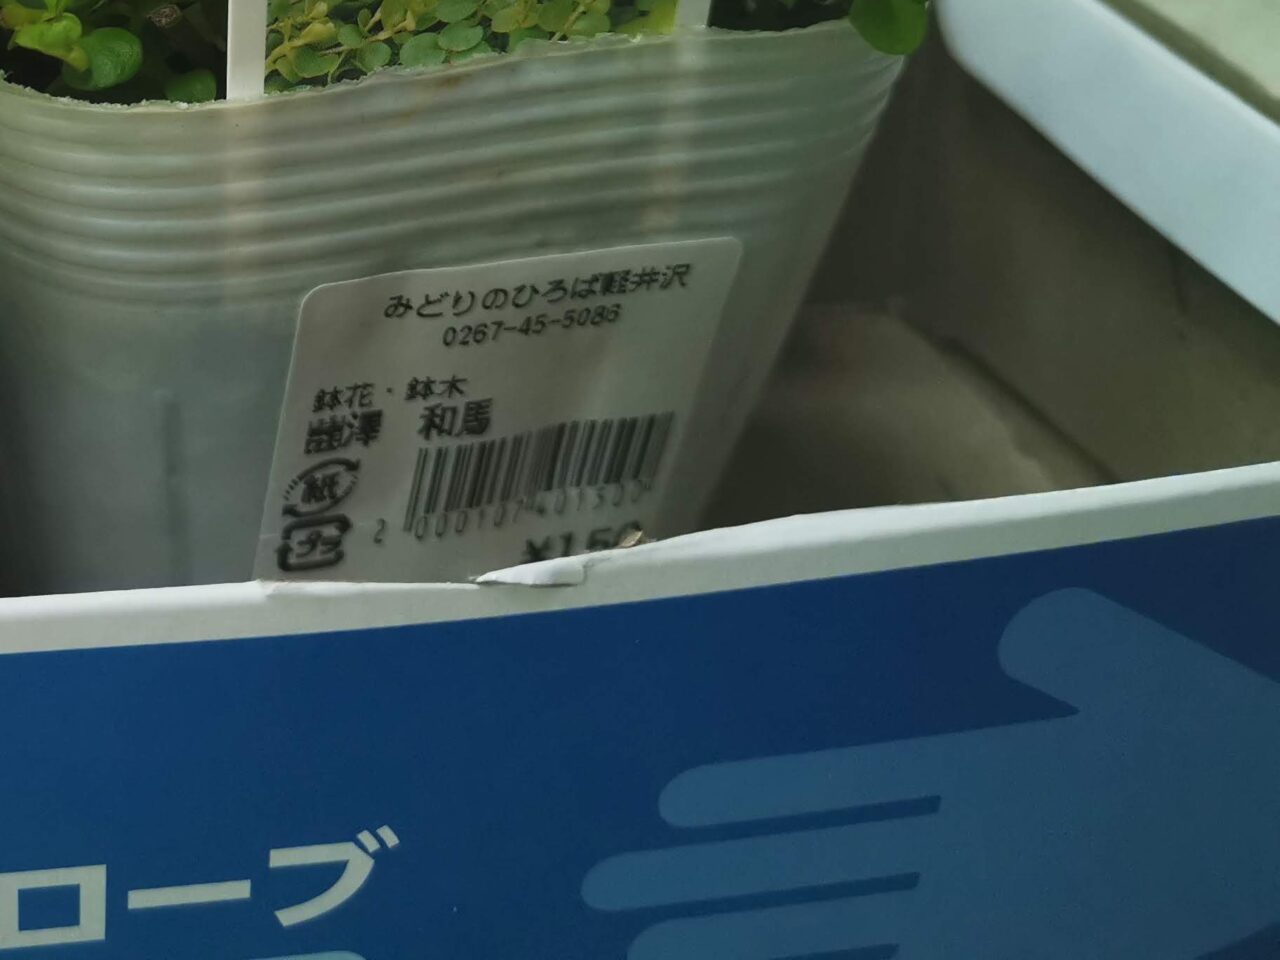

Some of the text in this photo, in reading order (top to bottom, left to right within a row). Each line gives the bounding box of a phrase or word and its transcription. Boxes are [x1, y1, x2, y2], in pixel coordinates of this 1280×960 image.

[384, 262, 692, 320] みどりのひろば軽井沢
[441, 302, 623, 348] 0267-45-5086
